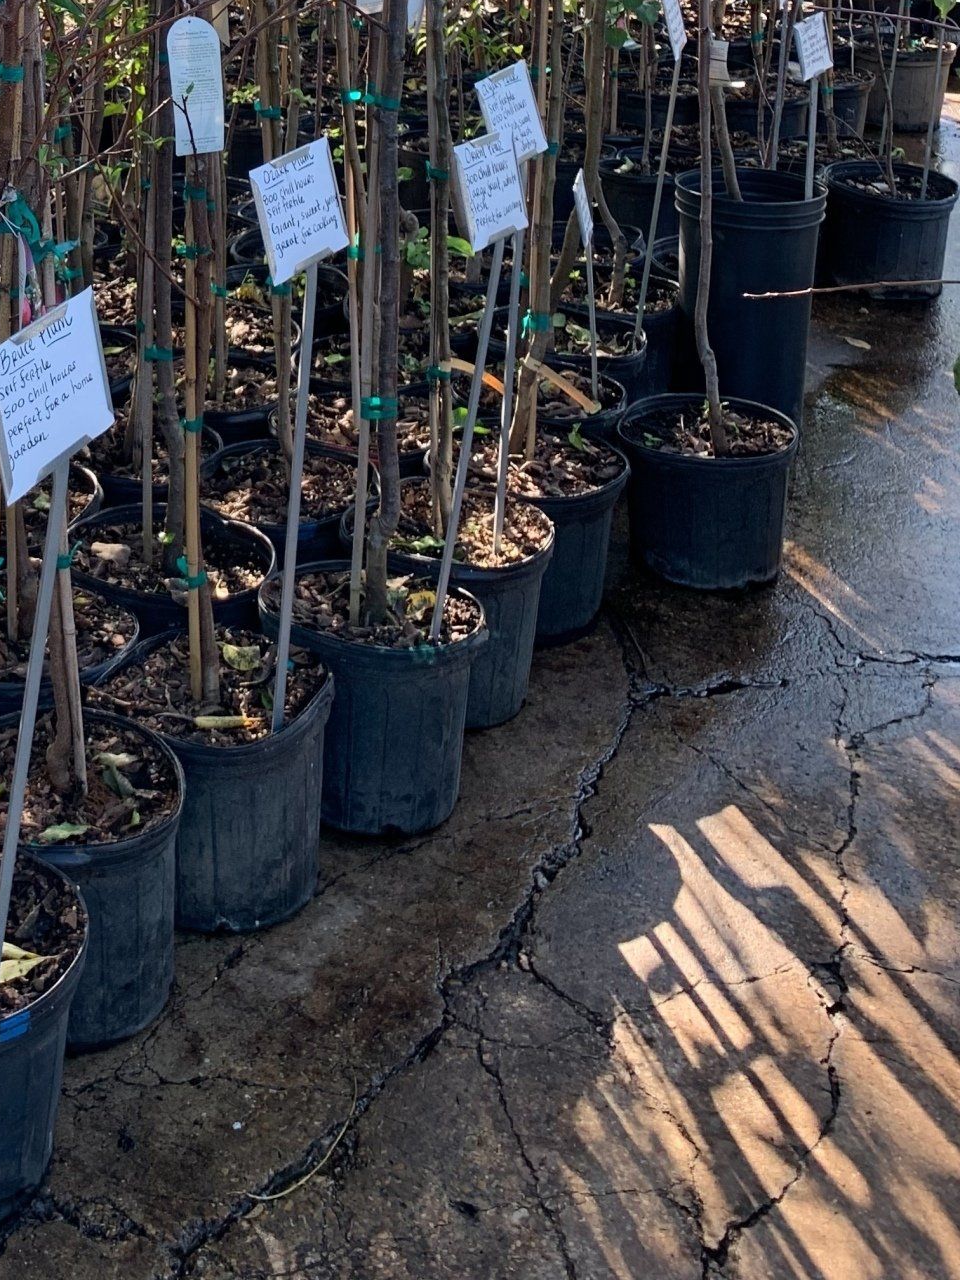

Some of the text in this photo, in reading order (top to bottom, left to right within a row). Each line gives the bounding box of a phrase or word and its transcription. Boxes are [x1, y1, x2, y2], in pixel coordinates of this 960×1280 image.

[262, 192, 278, 206] 800
[294, 174, 315, 191] hours
[263, 163, 290, 185] Ozark
[282, 194, 306, 213] fertile
[275, 232, 299, 258] great
[301, 226, 313, 245] for
[39, 316, 73, 345] Plum
[19, 358, 52, 389] fertile
[3, 398, 26, 420] 500
[50, 360, 76, 387] hours
[7, 372, 94, 448] perfect for a home
[8, 431, 50, 472] garden
